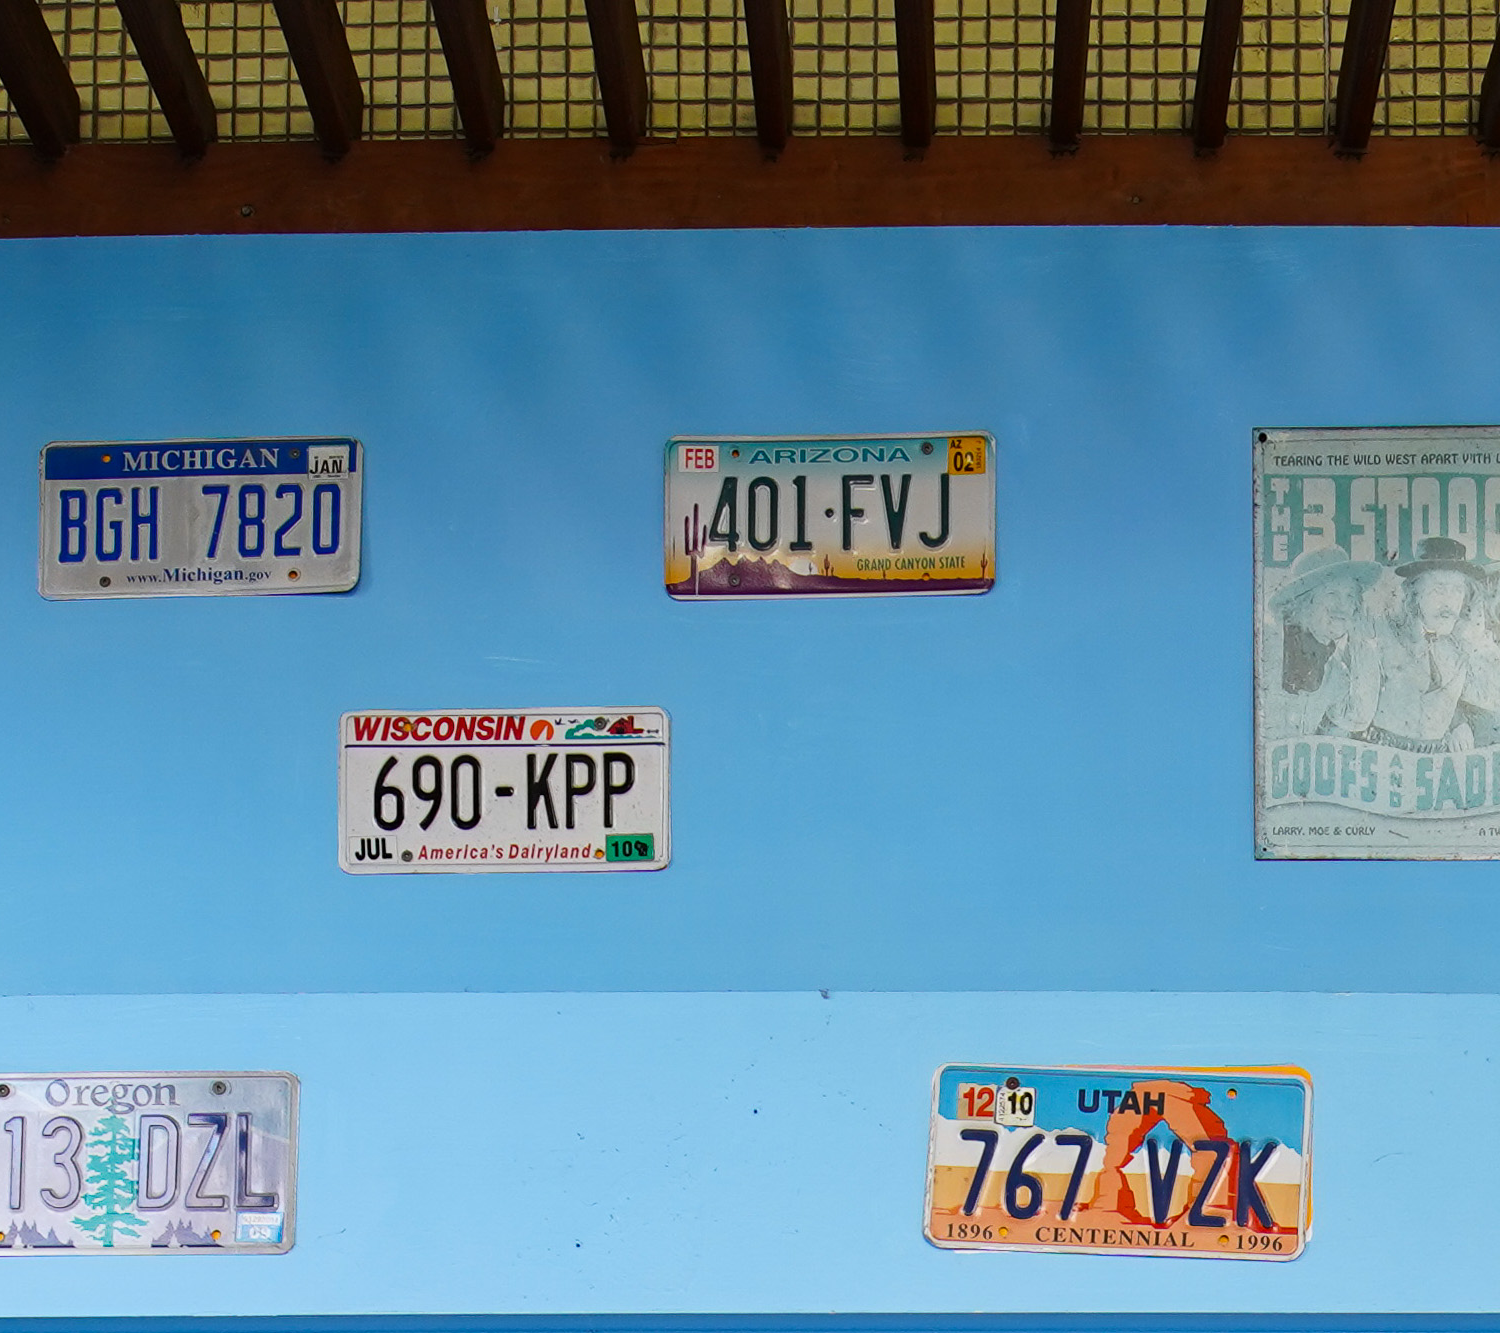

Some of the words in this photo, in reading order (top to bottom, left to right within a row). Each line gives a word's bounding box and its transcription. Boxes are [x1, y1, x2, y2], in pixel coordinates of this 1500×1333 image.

[122, 447, 280, 473] MICHIGAN
[309, 458, 344, 475] JAN
[683, 446, 716, 470] FEB
[748, 444, 913, 466] ARIZONA
[1273, 454, 1323, 467] TEARING
[1327, 454, 1350, 466] THE
[1353, 454, 1382, 466] WILD
[1385, 453, 1417, 465] WEST
[1420, 453, 1459, 465] APART
[58, 485, 159, 565] BGH
[202, 482, 342, 560] 7820
[856, 558, 892, 572] GRAND
[895, 557, 939, 571] CANYON
[940, 555, 967, 570] STATE
[126, 566, 273, 586] www.Michigan.gov
[352, 713, 528, 745] WISCONSIN
[1271, 742, 1379, 803] GOOFS
[371, 751, 637, 834] 690-KPP
[1308, 826, 1331, 837] MOE
[1345, 826, 1376, 837] CURLY
[354, 835, 394, 861] JUL
[416, 841, 506, 863] America's
[508, 840, 594, 862] Dairyland
[45, 1079, 181, 1115] Oregon
[962, 1087, 994, 1117] 12
[1007, 1092, 1034, 1115] 10
[1077, 1088, 1166, 1116] UTAH
[136, 1112, 280, 1211] DZL
[959, 1129, 1093, 1221] 767
[1146, 1137, 1277, 1228] VZK
[946, 1223, 993, 1241] 1896
[1035, 1226, 1196, 1249] CENTENNIAL
[1236, 1234, 1283, 1252] 1996
